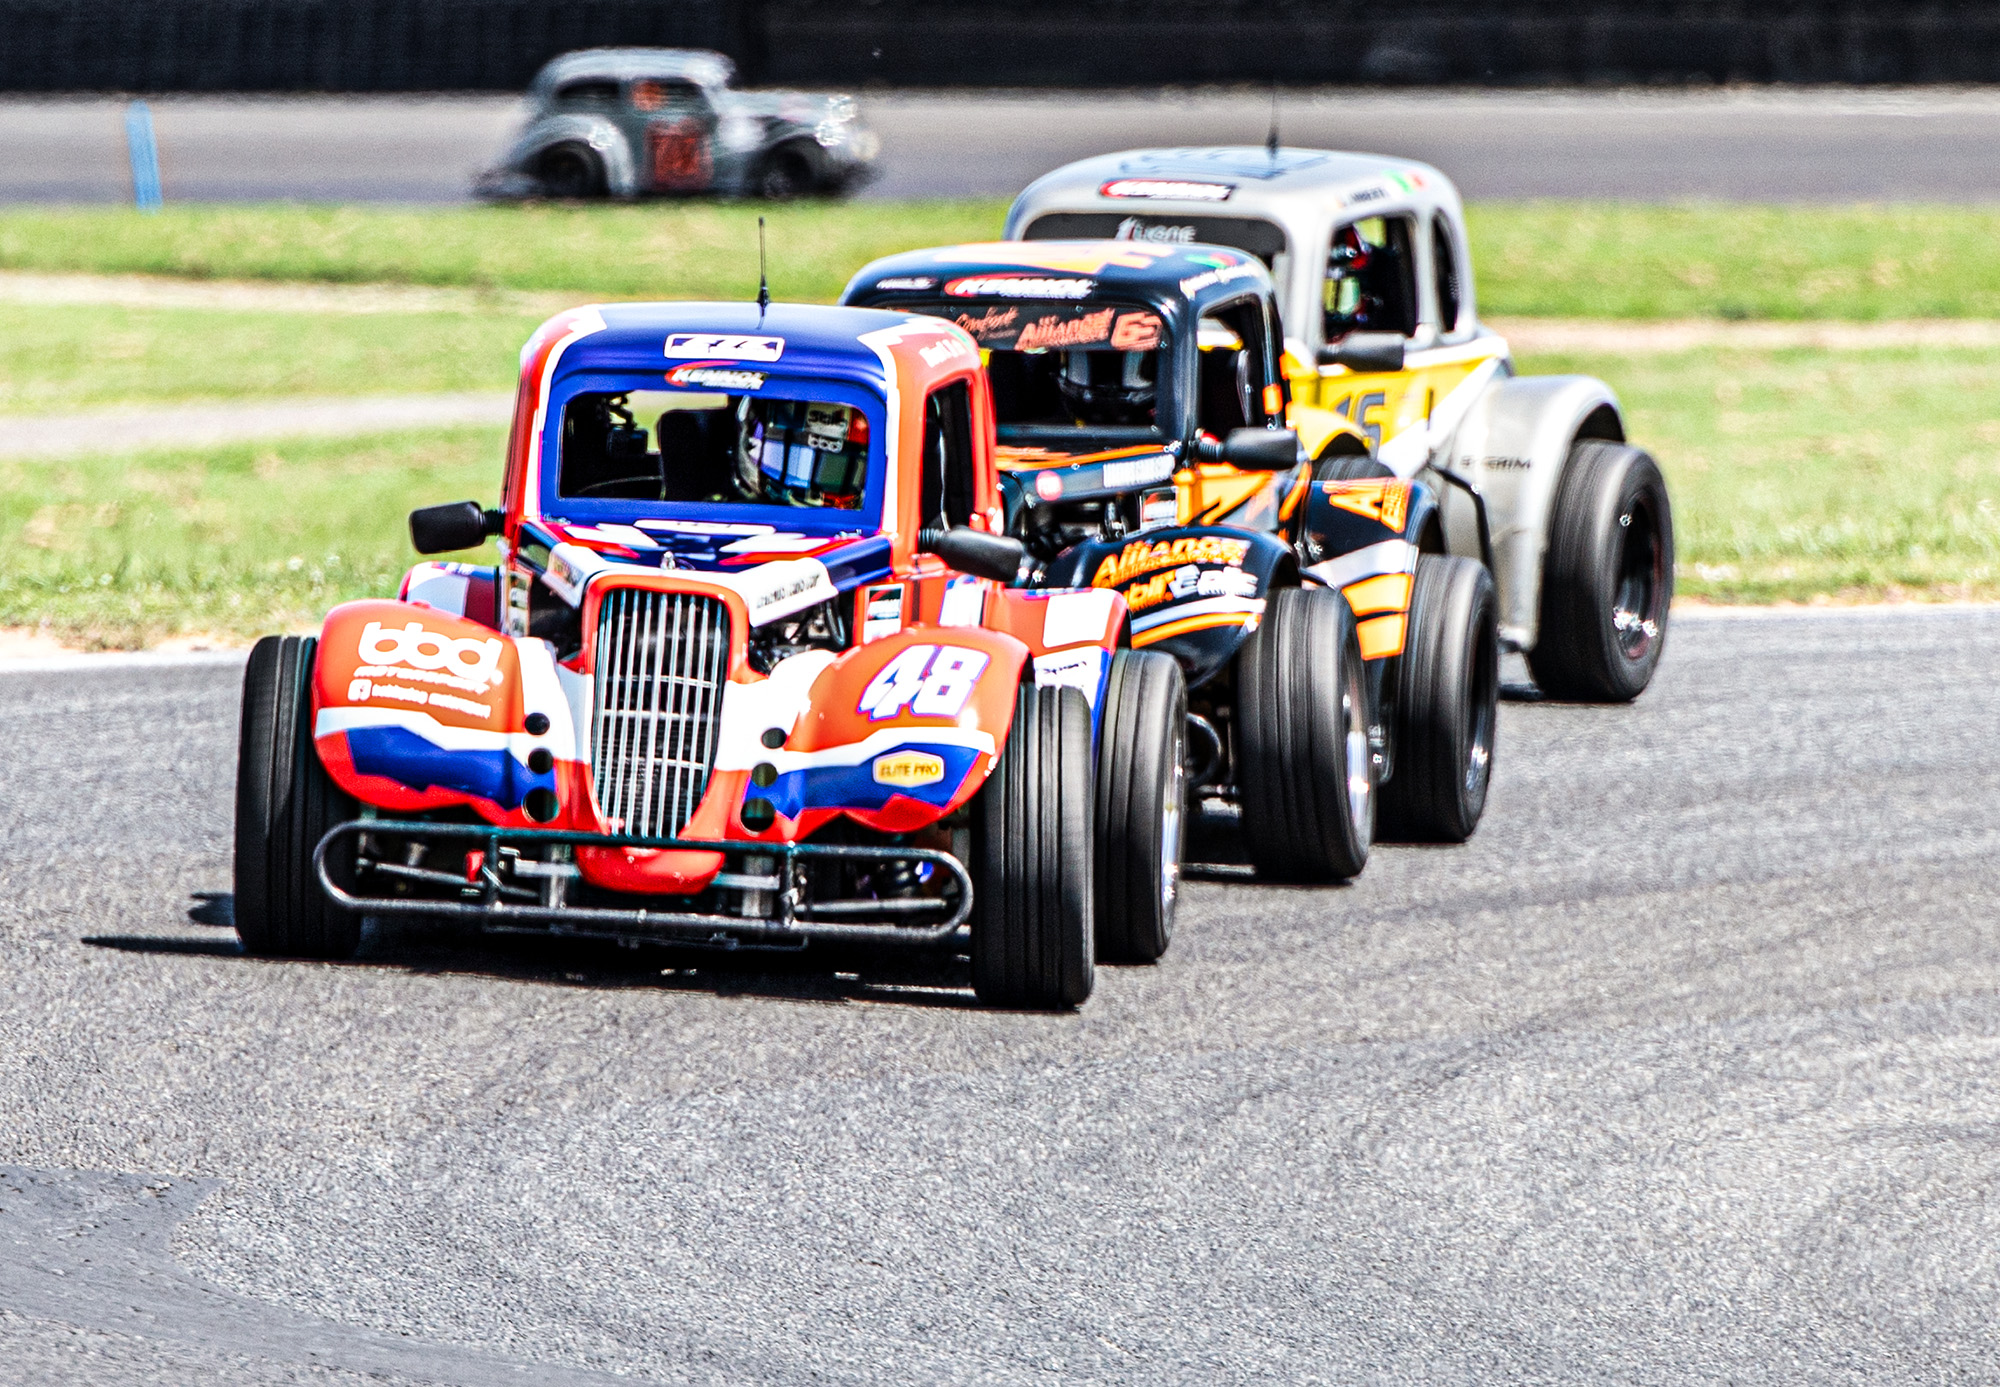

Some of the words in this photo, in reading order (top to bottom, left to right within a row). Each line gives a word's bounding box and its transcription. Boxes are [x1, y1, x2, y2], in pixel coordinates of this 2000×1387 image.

[857, 644, 991, 722] 48
[880, 763, 911, 777] ELITE
[914, 763, 940, 777] PRO
